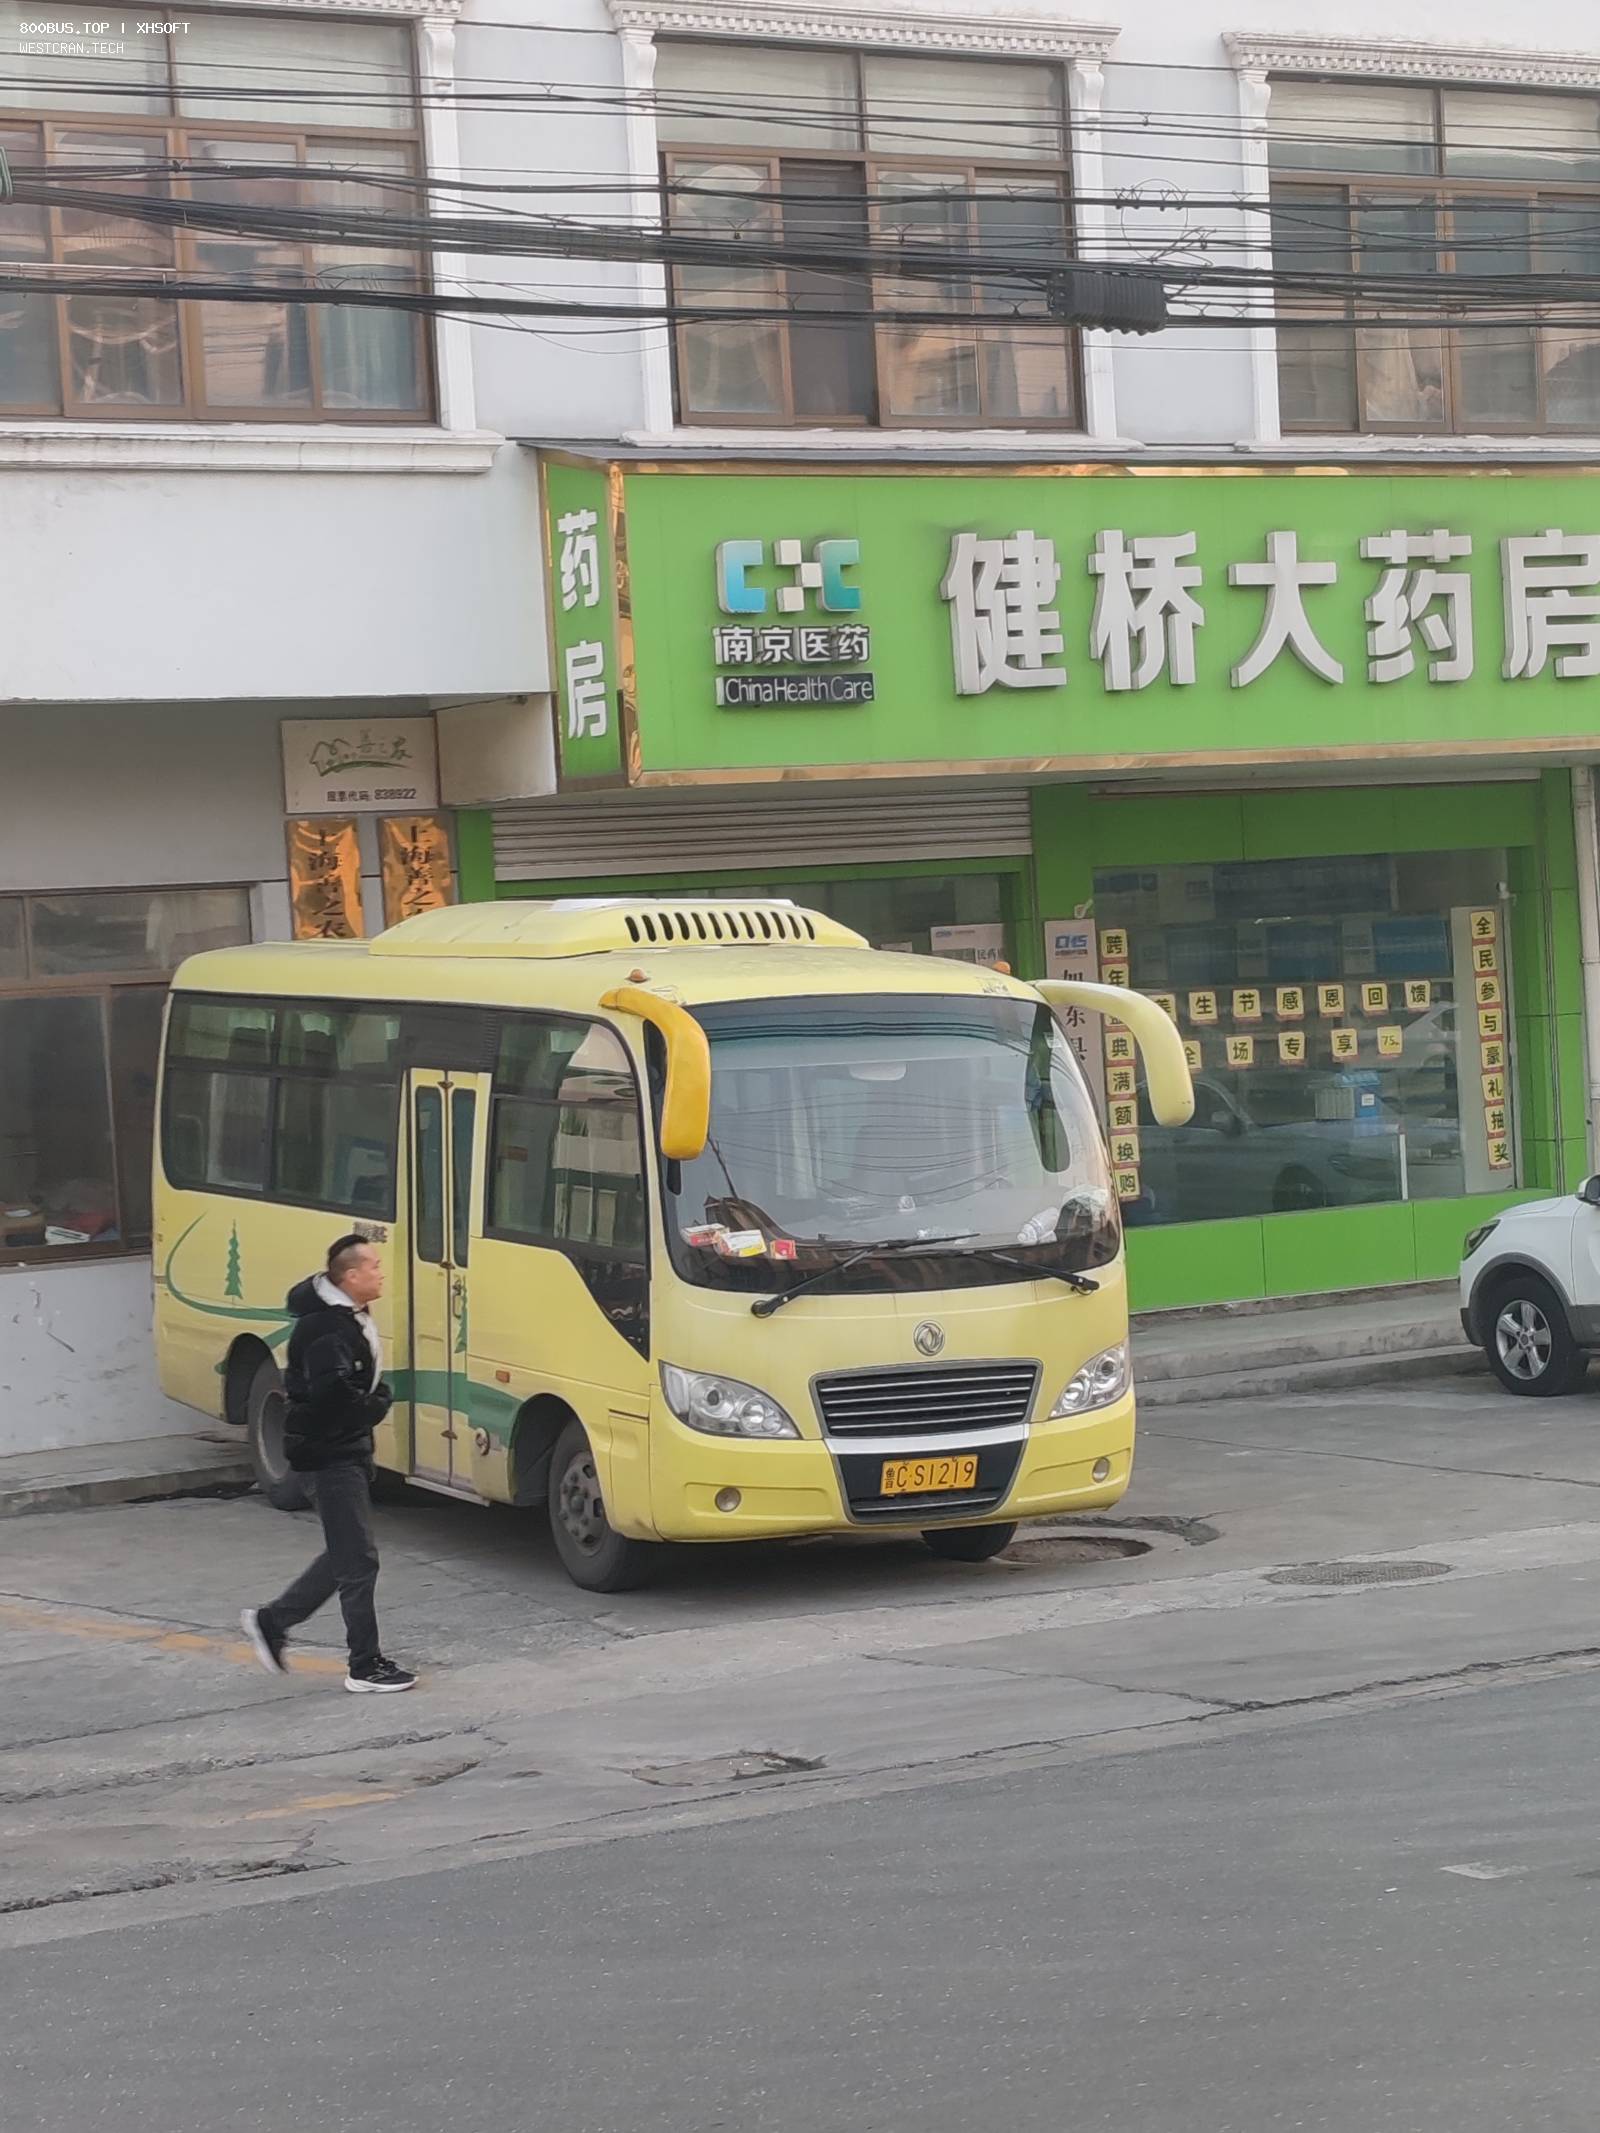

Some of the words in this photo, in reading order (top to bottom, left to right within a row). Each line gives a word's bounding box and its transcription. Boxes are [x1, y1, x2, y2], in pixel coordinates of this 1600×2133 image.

[557, 508, 607, 739] 药房
[714, 624, 871, 665] 南京医药
[941, 528, 1600, 695] 健桥大药房
[1476, 916, 1509, 1162] 全民参与豪礼抽奖
